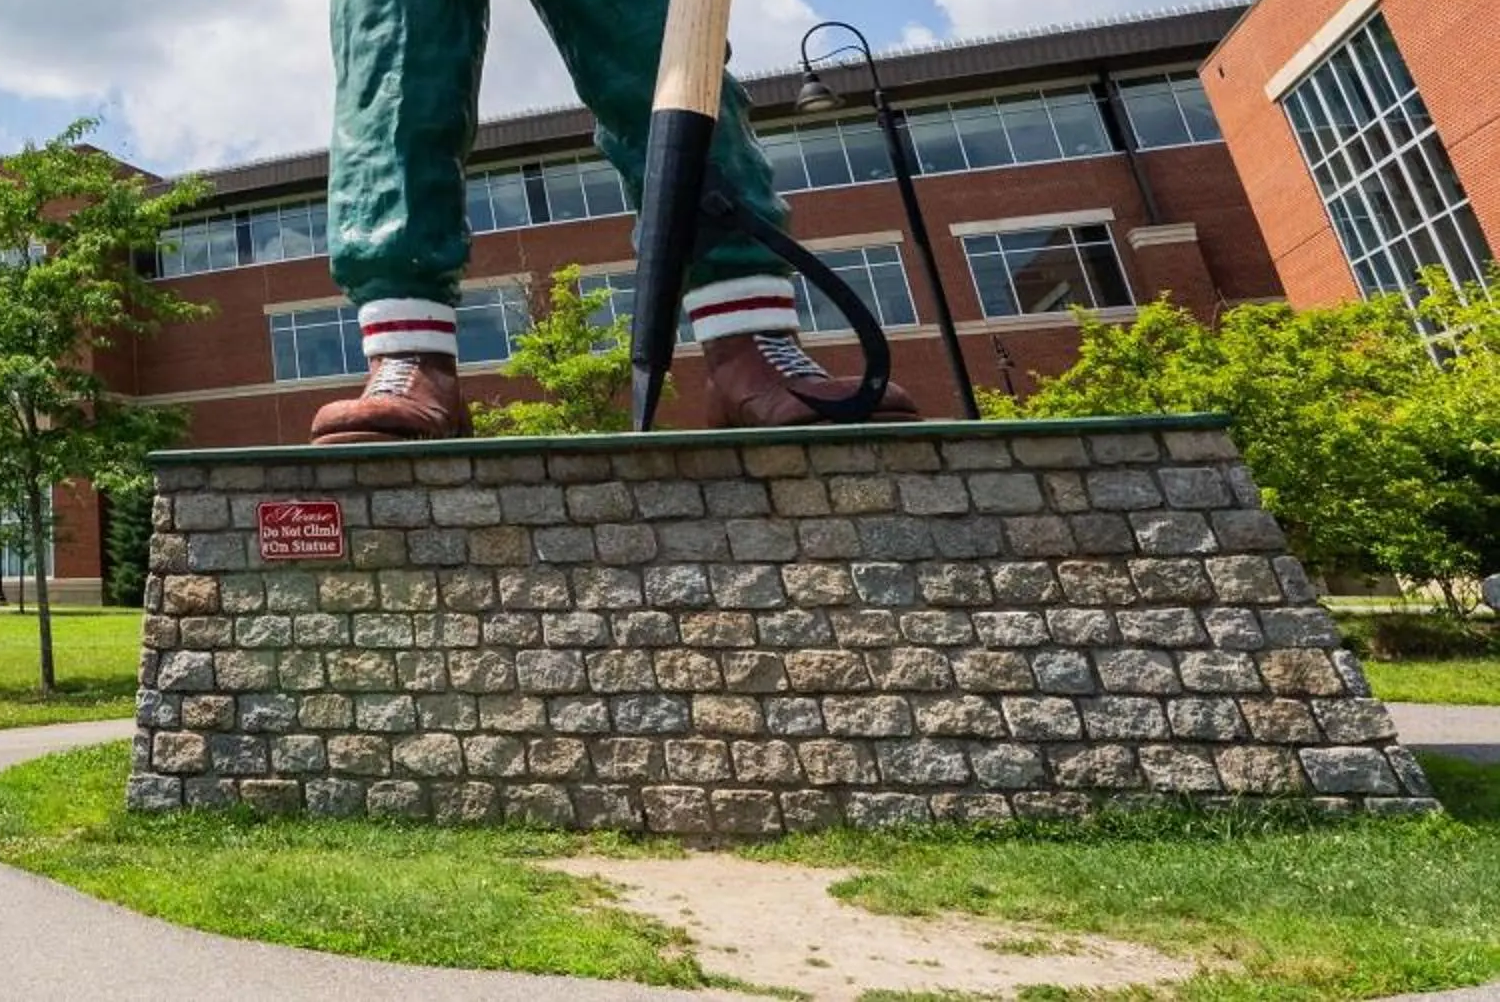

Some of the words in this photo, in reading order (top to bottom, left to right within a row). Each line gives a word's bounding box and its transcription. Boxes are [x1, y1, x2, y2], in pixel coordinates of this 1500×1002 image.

[265, 505, 333, 523] Please
[263, 527, 279, 538] Do
[281, 526, 301, 537] Not
[291, 540, 336, 552] Statue
